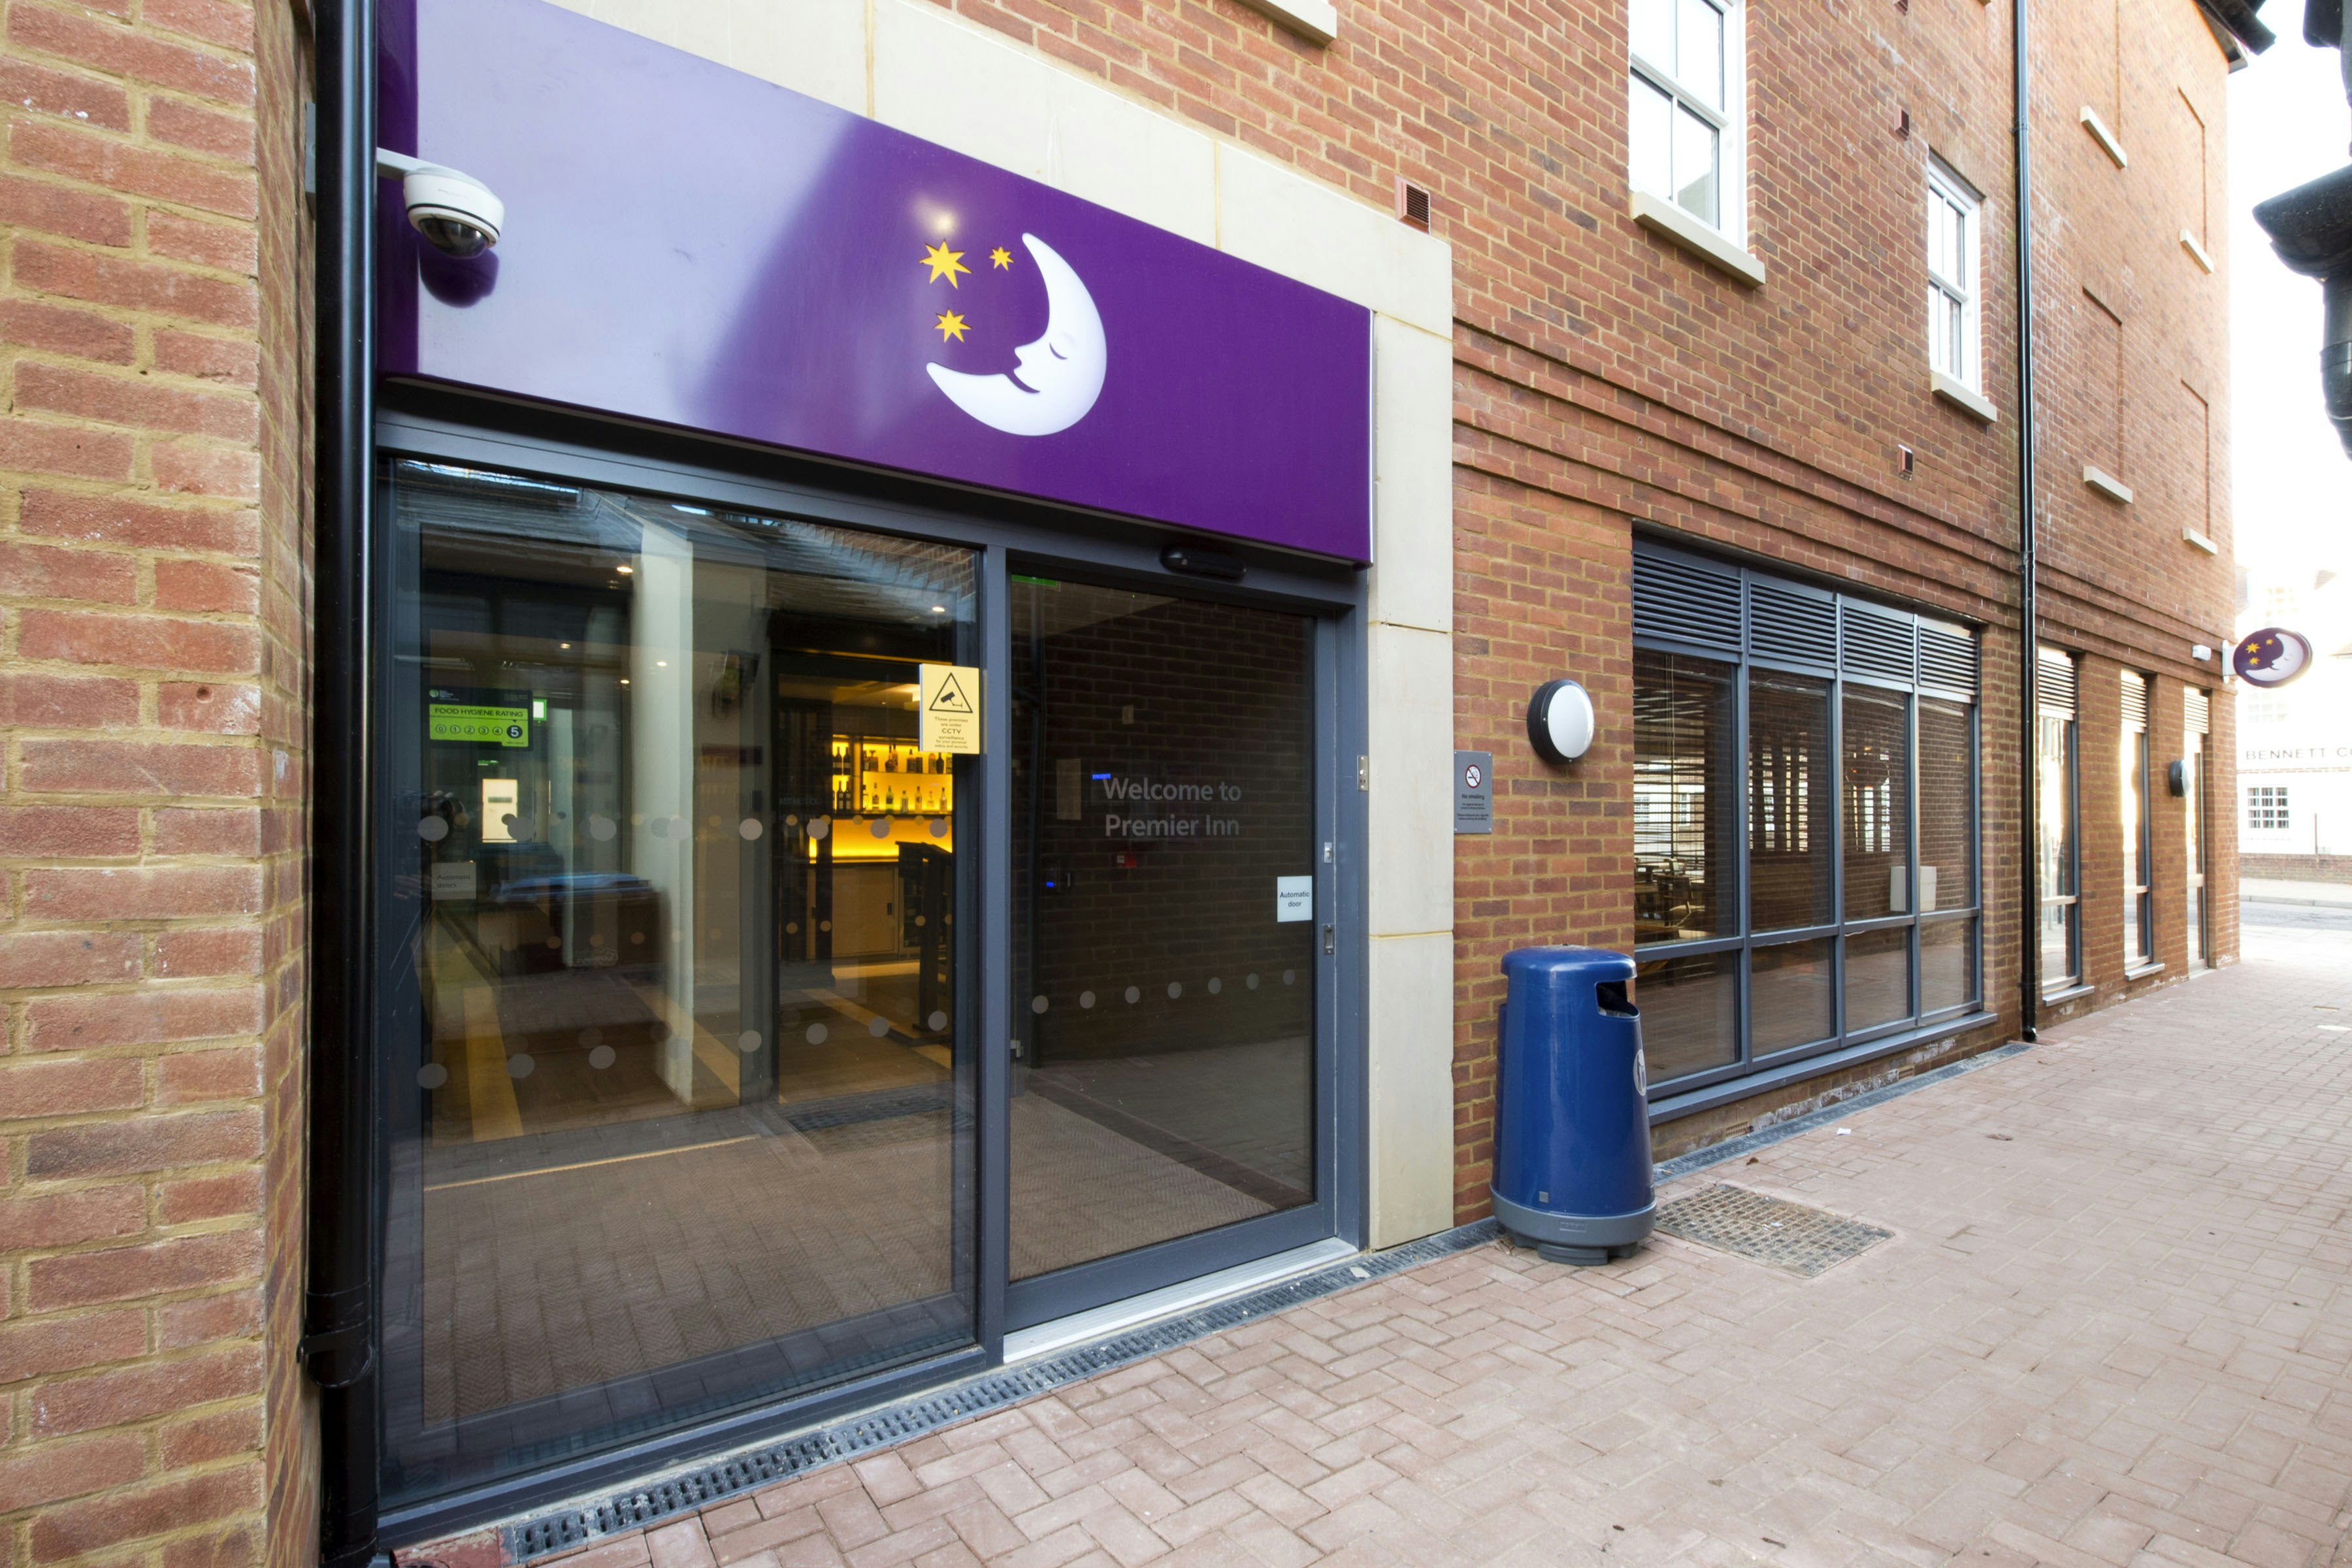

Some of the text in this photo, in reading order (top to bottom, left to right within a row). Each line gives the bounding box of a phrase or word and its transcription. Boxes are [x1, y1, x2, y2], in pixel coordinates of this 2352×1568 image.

[510, 727, 519, 737] 5
[2246, 748, 2326, 760] BENNETT
[1102, 777, 1242, 802] Welcome to
[1105, 814, 1239, 837] Premier Inn
